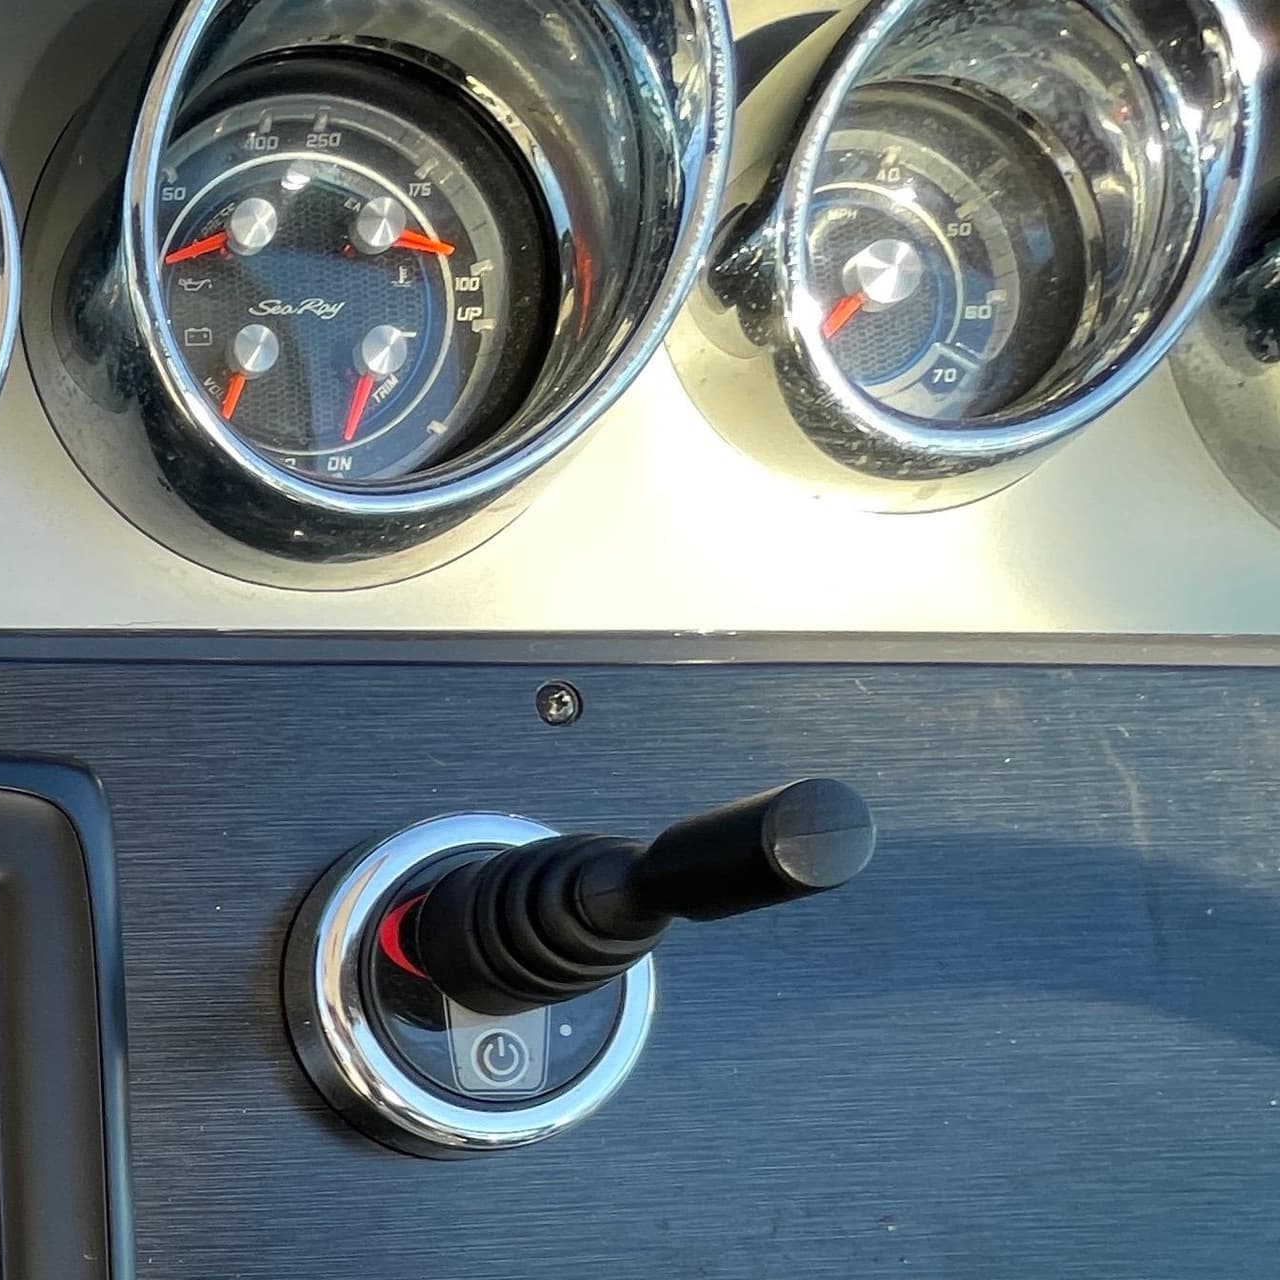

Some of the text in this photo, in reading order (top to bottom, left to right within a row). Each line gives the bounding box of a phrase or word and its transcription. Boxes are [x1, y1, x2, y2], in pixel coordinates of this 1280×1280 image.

[306, 133, 342, 148] 250
[876, 167, 901, 182] 40
[162, 186, 186, 201] 50
[947, 222, 972, 237] 50
[455, 277, 479, 291] 100
[457, 307, 483, 323] UP
[964, 305, 991, 320] 60
[932, 367, 957, 384] 70
